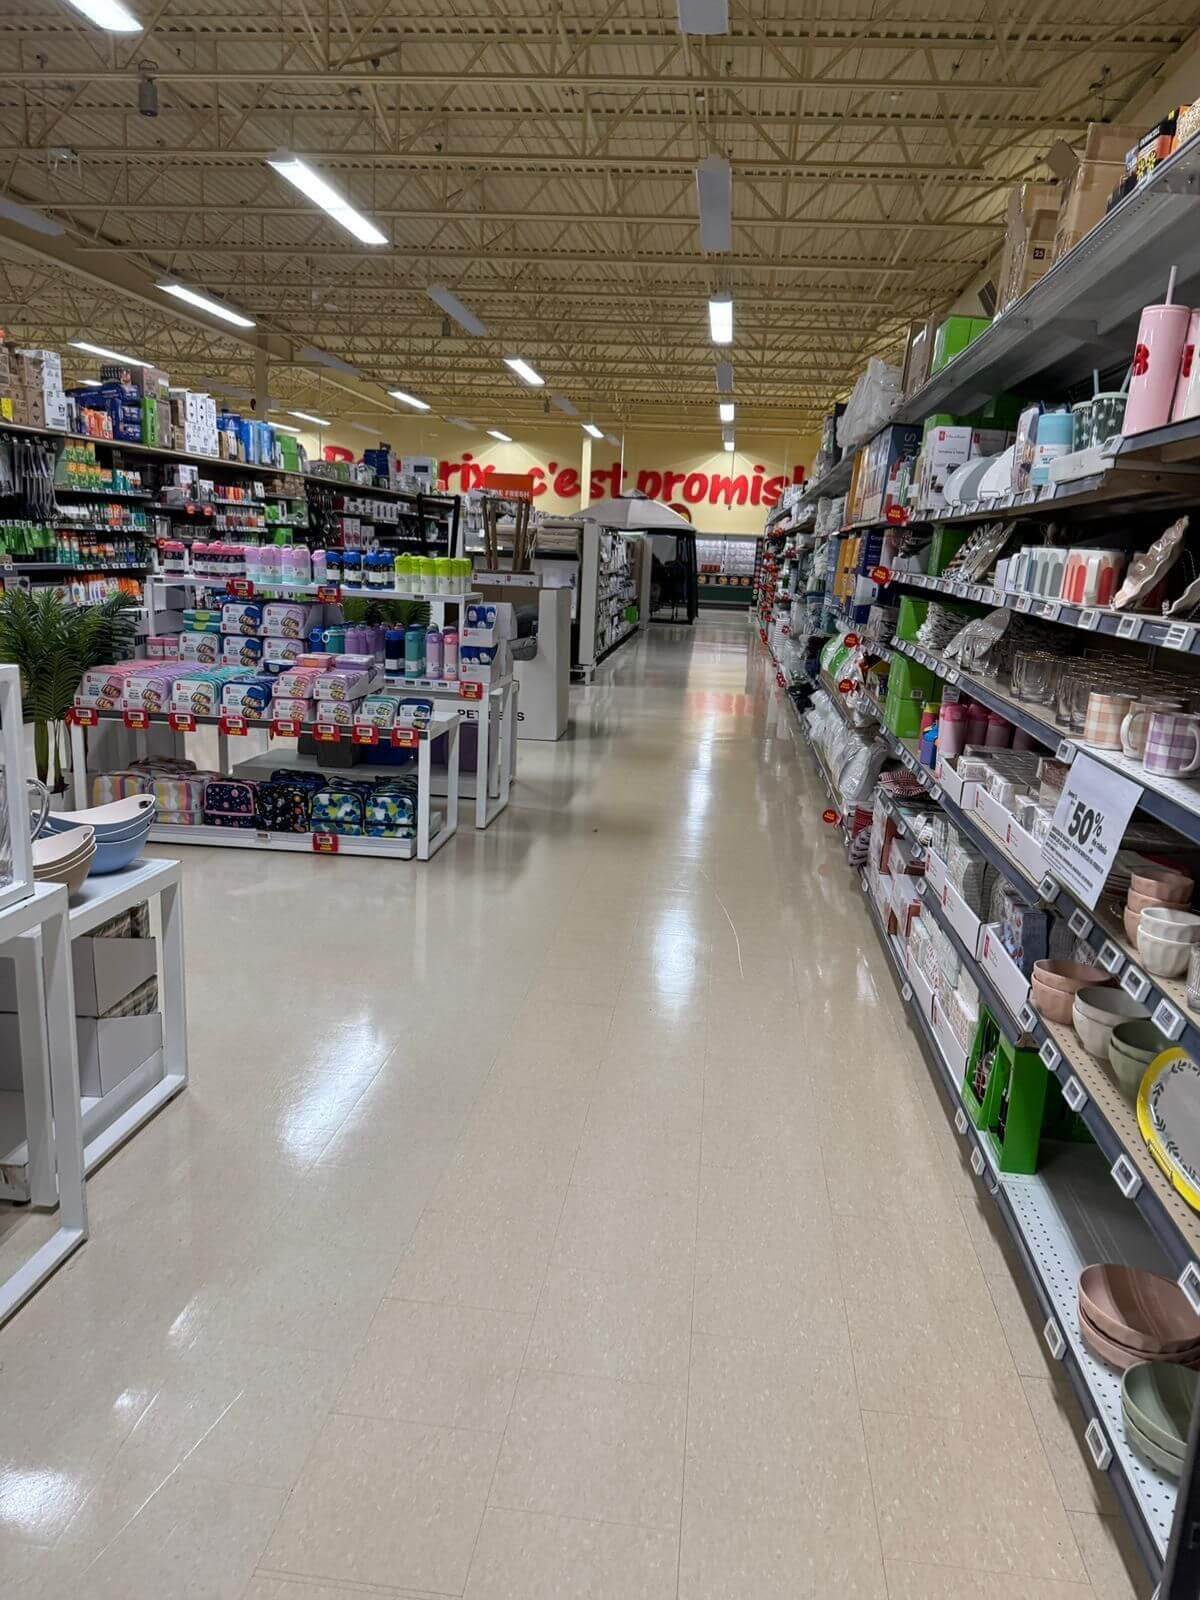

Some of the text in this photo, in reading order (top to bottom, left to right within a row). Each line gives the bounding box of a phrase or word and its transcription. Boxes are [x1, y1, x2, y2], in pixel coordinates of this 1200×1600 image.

[438, 453, 805, 507] rix c'est promis!
[1067, 801, 1105, 845] 50%
